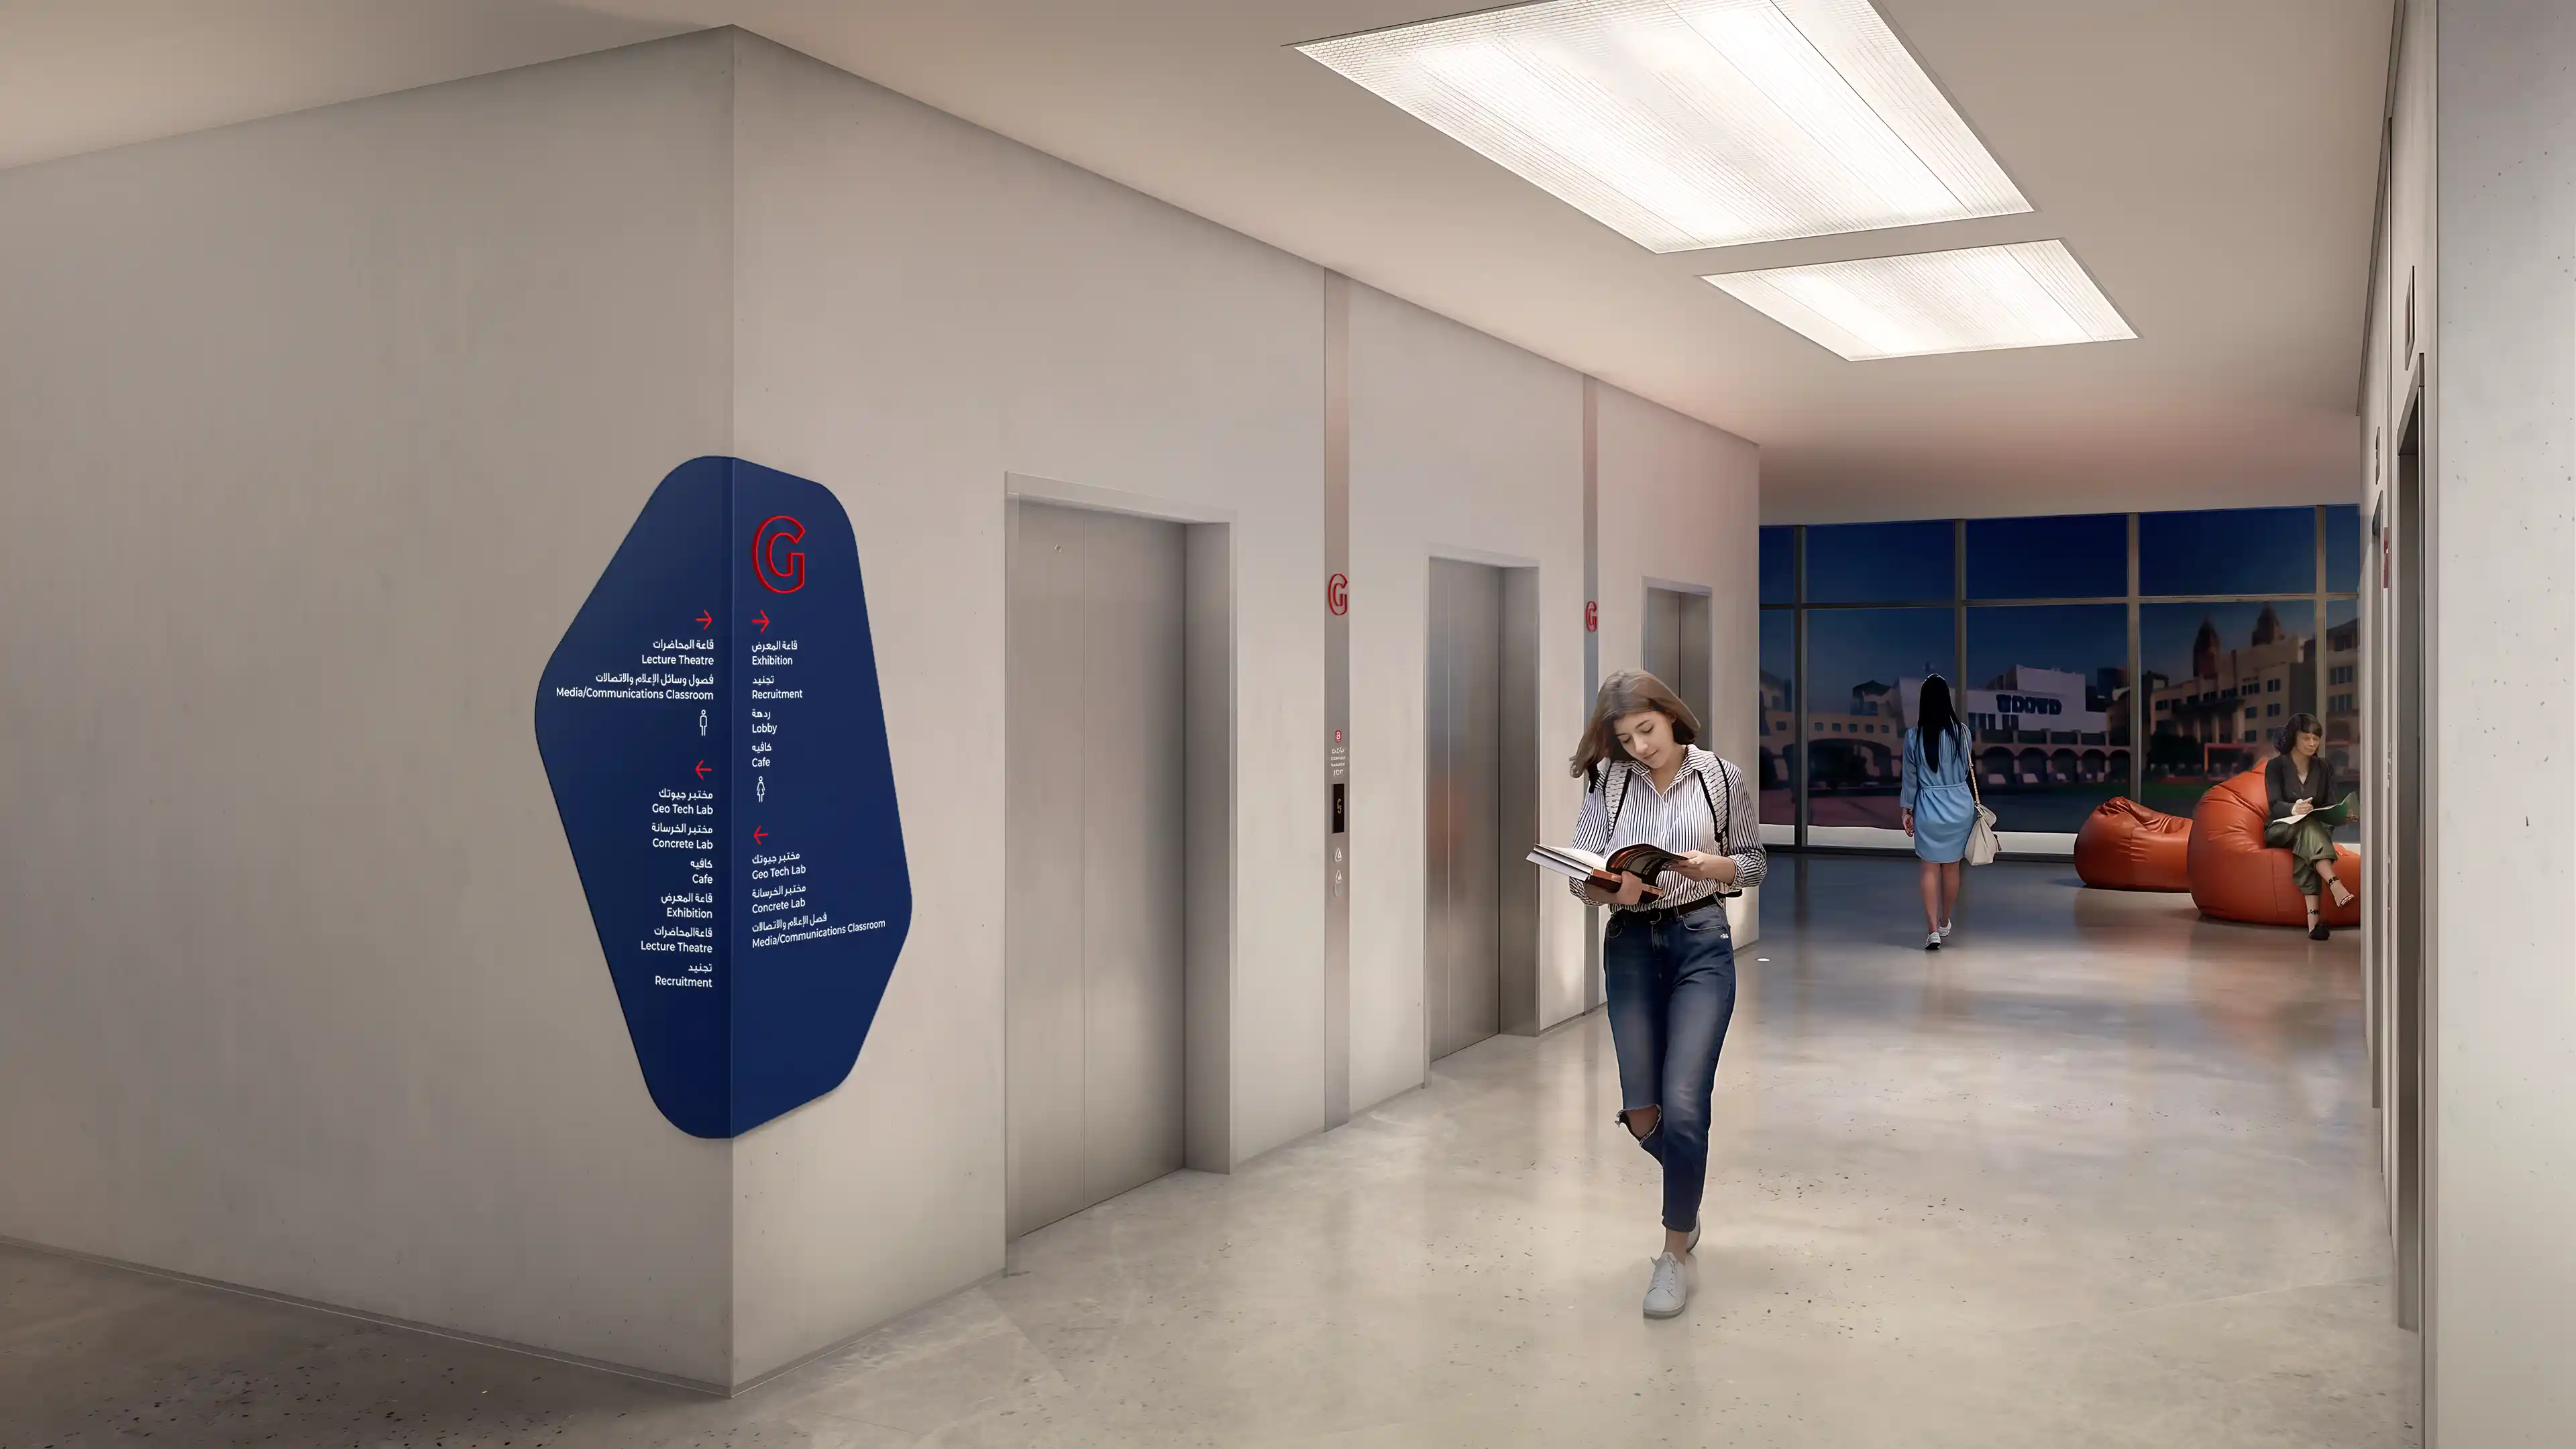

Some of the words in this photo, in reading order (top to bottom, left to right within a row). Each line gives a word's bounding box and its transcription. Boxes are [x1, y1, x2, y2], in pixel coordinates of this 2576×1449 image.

[751, 515, 806, 594] G
[1328, 574, 1348, 616] G
[1585, 600, 1598, 633] G
[653, 639, 695, 651] المحاضرات
[696, 639, 714, 650] قاعة
[751, 641, 781, 653] المعرض
[782, 640, 798, 650] قاعة
[641, 654, 677, 665] Lecture
[678, 654, 714, 665] Theatre
[751, 655, 793, 665] Exhibition
[595, 672, 634, 686] والاتصالات
[660, 673, 687, 687] وسائل
[688, 674, 714, 687] فصول
[752, 676, 774, 686] تجنيد
[556, 686, 664, 699] Media/Communications
[665, 689, 714, 700] Classroom
[752, 688, 803, 700] Recruitment
[752, 722, 777, 735] Lobby
[751, 741, 772, 754] كافيه
[751, 757, 771, 767] Cafe
[658, 788, 686, 801] جيوتك
[687, 790, 713, 802] مختبر
[651, 803, 670, 814] Geo
[672, 804, 694, 814] Tech
[696, 804, 714, 815] Lab
[651, 822, 686, 835] الخرسانة
[687, 824, 713, 836] مختبر
[652, 838, 694, 849] Concrete
[696, 839, 713, 850] Lab
[690, 857, 713, 870] كافيه
[751, 854, 777, 866] جيوتك
[777, 851, 800, 864] مختبر
[751, 869, 769, 879] Geo
[769, 866, 790, 877] Tech
[791, 864, 806, 875] Lab
[692, 873, 713, 884] Cafe
[751, 885, 784, 899] الخرسانة
[784, 884, 806, 897] مختبر
[661, 892, 694, 904] المعرض
[694, 892, 712, 903] قاعة
[751, 901, 790, 914] Concrete
[791, 897, 806, 908] Lab
[667, 907, 712, 918] Exhibition
[809, 912, 827, 926] فصل
[752, 918, 786, 932] والاتصالات
[752, 926, 847, 949] Media/Communications
[847, 920, 885, 933] Classroom
[641, 940, 676, 952] Lecture
[677, 942, 713, 953] Theatre
[688, 963, 712, 974] تجنيد
[655, 975, 712, 988] Recruitment
